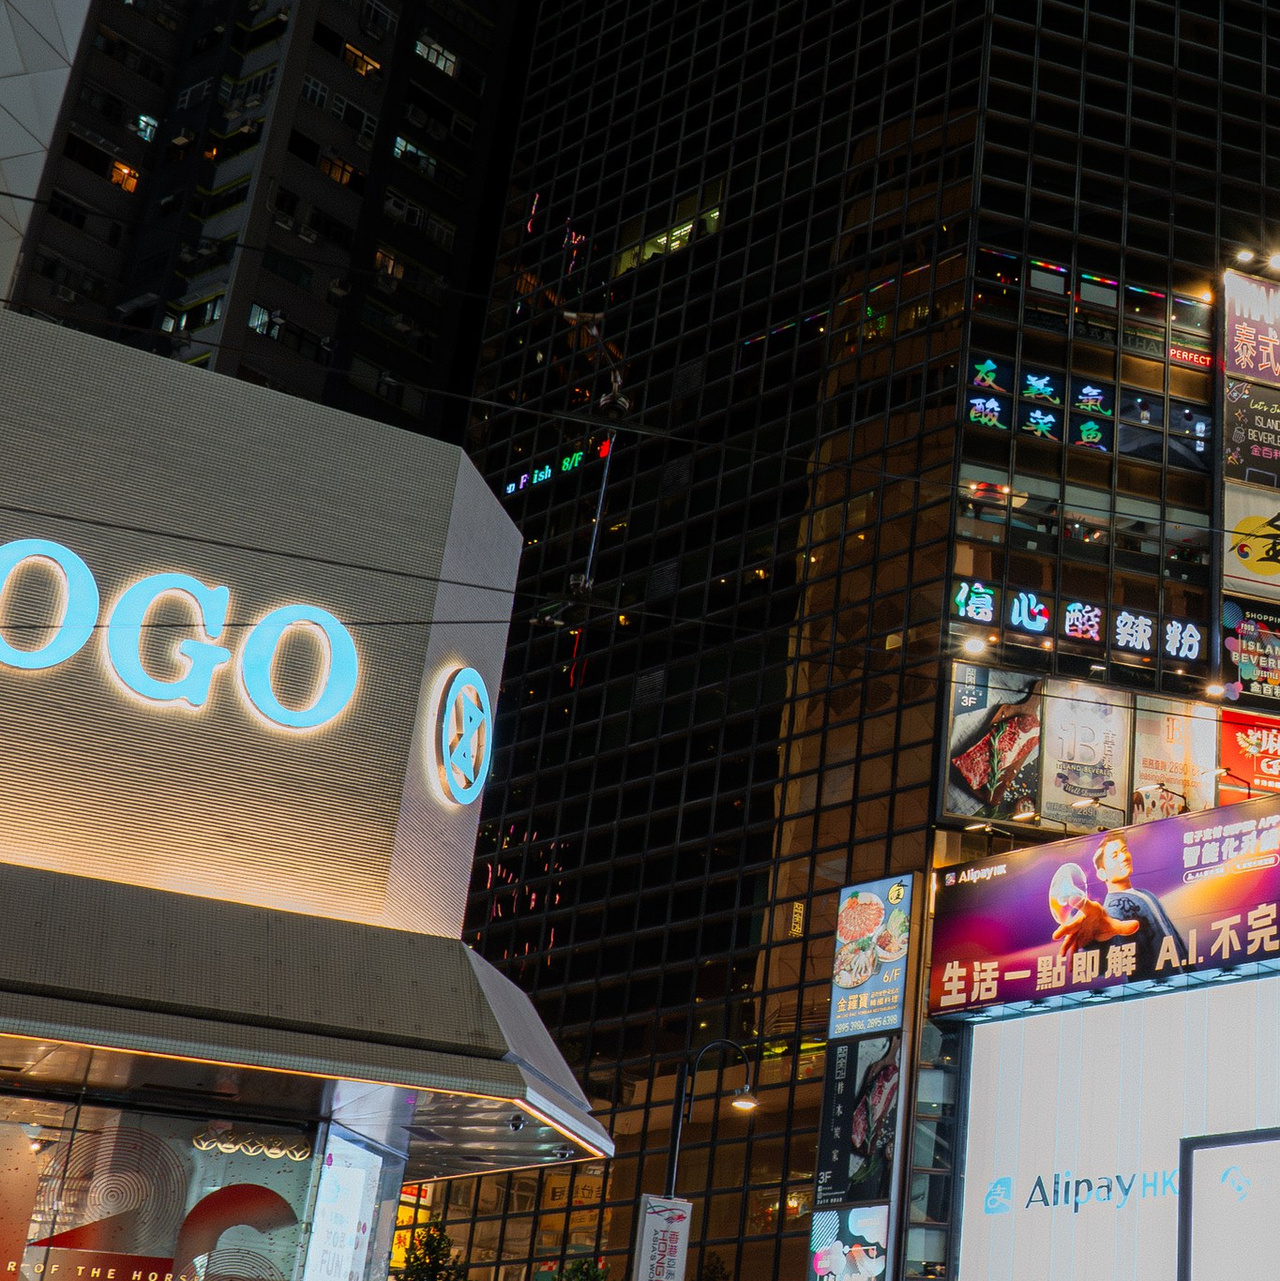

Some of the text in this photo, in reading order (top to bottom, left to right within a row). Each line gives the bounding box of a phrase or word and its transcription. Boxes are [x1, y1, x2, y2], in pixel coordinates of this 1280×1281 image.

[1169, 348, 1212, 366] PERFECT
[1250, 399, 1268, 411] Let's
[969, 398, 1107, 452] 酸菜魚
[562, 452, 583, 471] 8/F
[961, 696, 977, 707] 3F
[958, 863, 1007, 885] AlipayHK
[882, 968, 901, 983] 6/F
[940, 942, 1137, 1008] 生活一點即解
[837, 992, 869, 1012] 金羅寶
[818, 1170, 832, 1184] 3F
[1025, 1169, 1179, 1213] AlipayHK
[650, 1228, 658, 1263] ASIA'S
[654, 1229, 668, 1277] HONG
[34, 1263, 59, 1274] OF
[77, 1266, 116, 1279] THE
